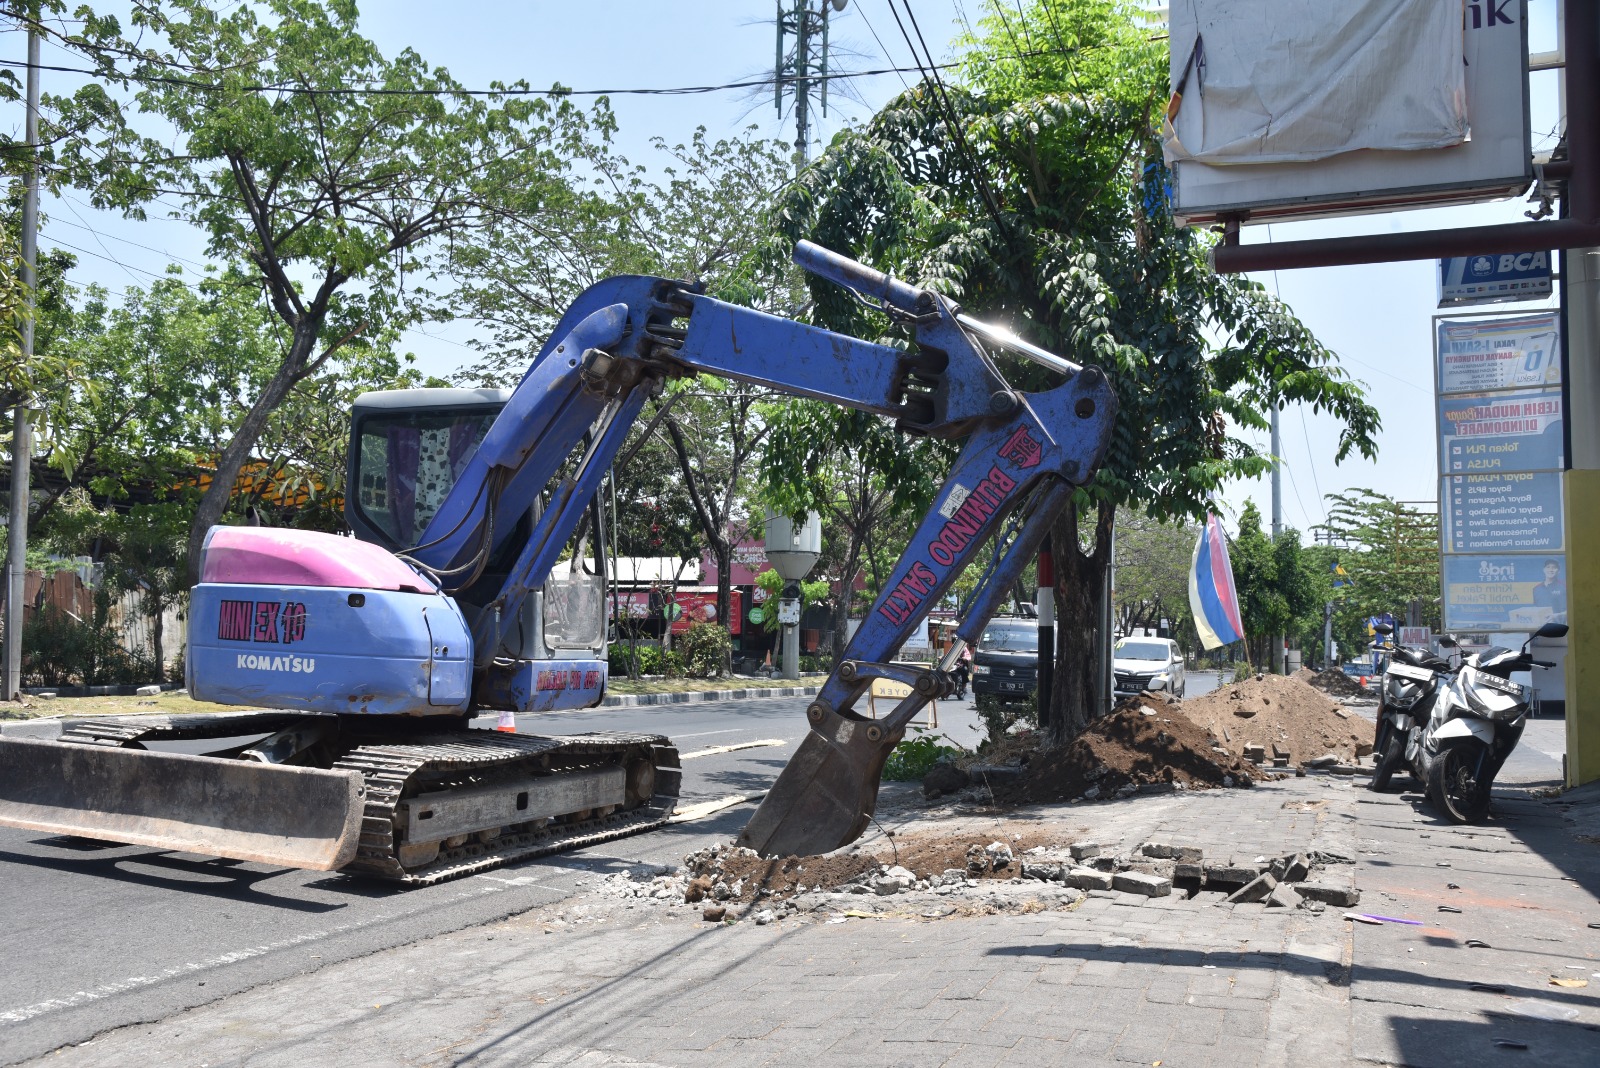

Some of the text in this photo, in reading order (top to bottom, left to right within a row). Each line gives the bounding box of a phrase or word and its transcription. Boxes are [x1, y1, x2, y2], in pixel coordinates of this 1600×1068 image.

[1498, 252, 1547, 272] BCA
[877, 464, 1019, 627] BUMINDO SAKTI
[218, 600, 254, 641] MINI
[254, 602, 282, 643] EX
[237, 654, 315, 673] KOMATSU
